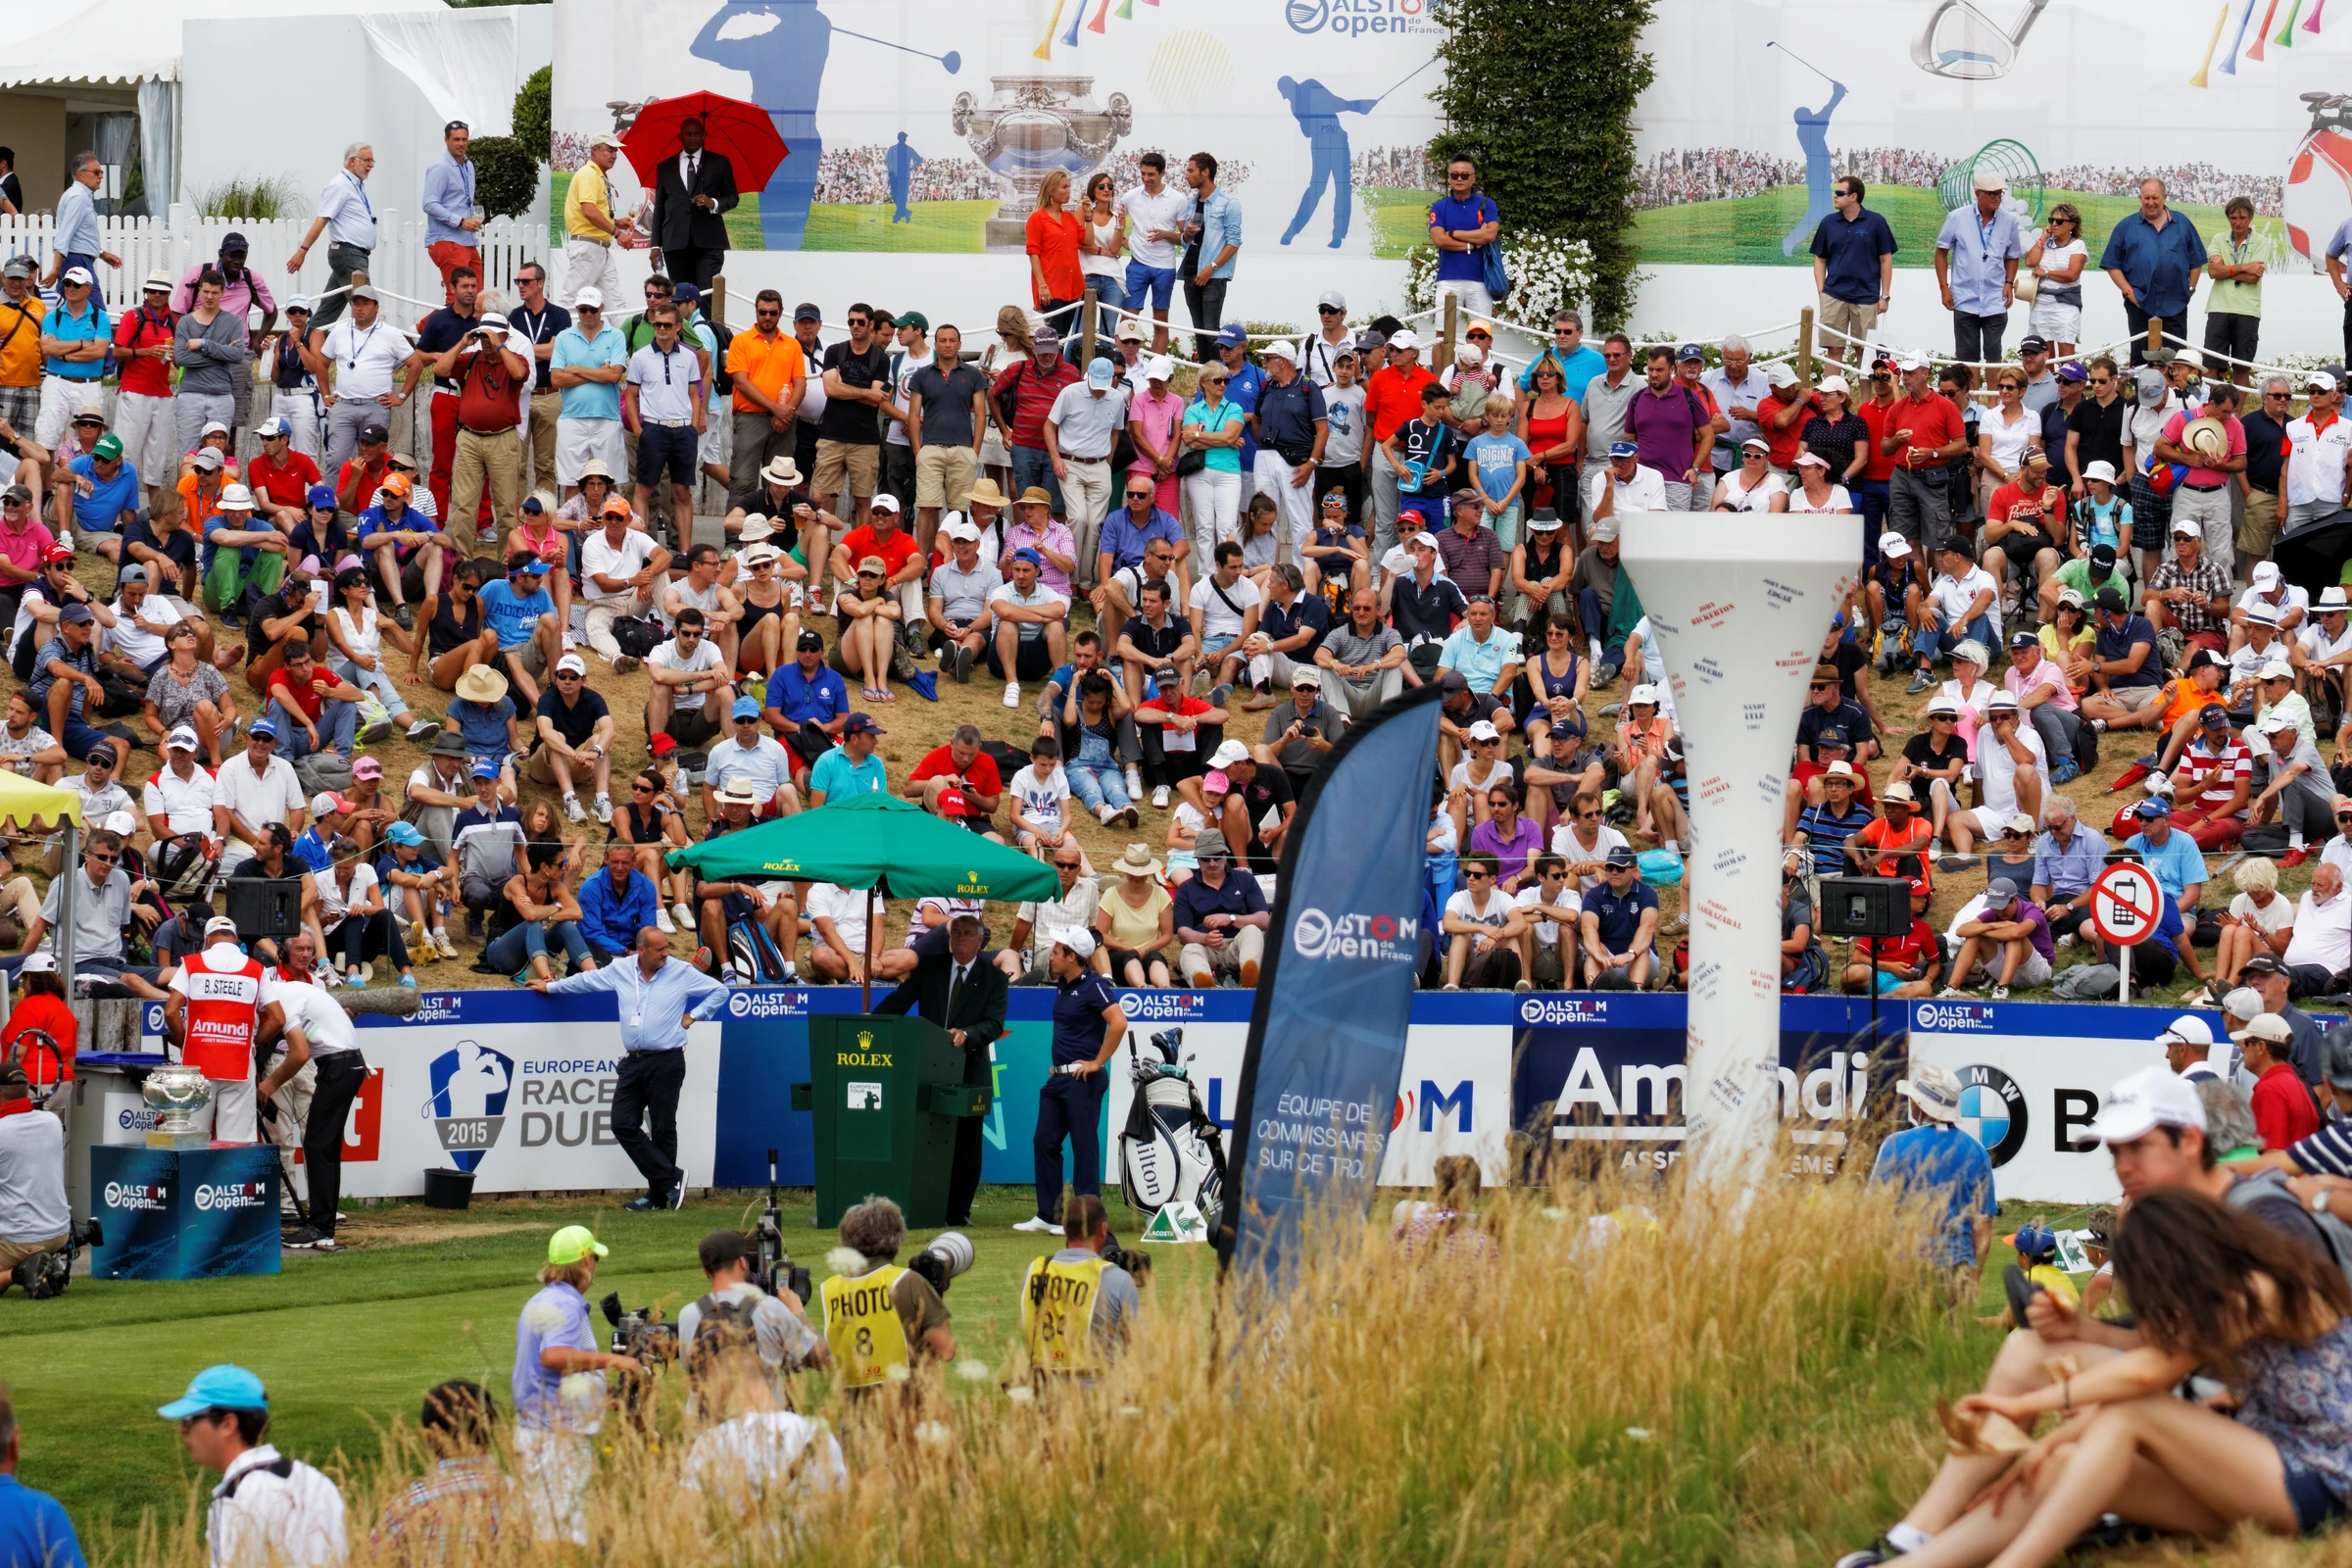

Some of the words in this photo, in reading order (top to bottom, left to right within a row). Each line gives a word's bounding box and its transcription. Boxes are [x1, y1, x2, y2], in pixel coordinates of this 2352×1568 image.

[1332, 15, 1406, 38] open
[1408, 25, 1445, 34] France
[1477, 447, 1515, 466] ORIGINA
[1886, 537, 1903, 548] PING
[1767, 588, 1792, 604] EDGAR
[490, 602, 541, 618] ADIDAS
[1690, 602, 1736, 626] BICKERTON
[1693, 662, 1724, 679] RIVERO
[1743, 703, 1766, 711] SANDY
[1744, 711, 1765, 720] LYLE
[1699, 782, 1733, 800] JAECKEL
[1756, 780, 1781, 797] NELSON
[948, 796, 964, 805] PING
[1717, 848, 1736, 858] DAVE
[762, 862, 801, 872] ROLEX
[1712, 853, 1747, 871] THOMAS
[956, 884, 990, 895] ROLEX
[1380, 950, 1413, 962] France
[204, 979, 212, 994] B.
[214, 979, 243, 997] STEELE
[1751, 979, 1771, 991] HUAN
[752, 992, 808, 1005] ALSTOM
[1143, 994, 1204, 1007] ALSTOM
[1545, 1000, 1607, 1013] ALSTOM
[417, 1006, 447, 1023] open
[751, 1004, 789, 1018] open
[1143, 1005, 1184, 1020] open
[1545, 1010, 1587, 1025] open
[1938, 1005, 1993, 1019] ALSTOM
[192, 1018, 249, 1037] Amundi
[1937, 1015, 1975, 1031] open
[523, 1059, 619, 1074] EUROPEAN
[836, 1053, 894, 1067] ROLEX
[521, 1078, 615, 1105] RACE
[1553, 1047, 1870, 1120] Amndi
[1971, 1066, 2023, 1103] MW
[1277, 1089, 1343, 1122] ÉQUIPE
[1346, 1101, 1372, 1123] DE
[448, 1121, 487, 1145] 2015
[1256, 1119, 1385, 1152] COMMISSAIRES
[1259, 1148, 1294, 1170] SUR
[1298, 1152, 1323, 1174] CE
[122, 1184, 167, 1199] ALSTOM
[215, 1182, 266, 1197] ALSTOM
[122, 1197, 152, 1210] open
[215, 1195, 249, 1211] open
[829, 1284, 892, 1323] PHOTO
[856, 1326, 874, 1358] 8
